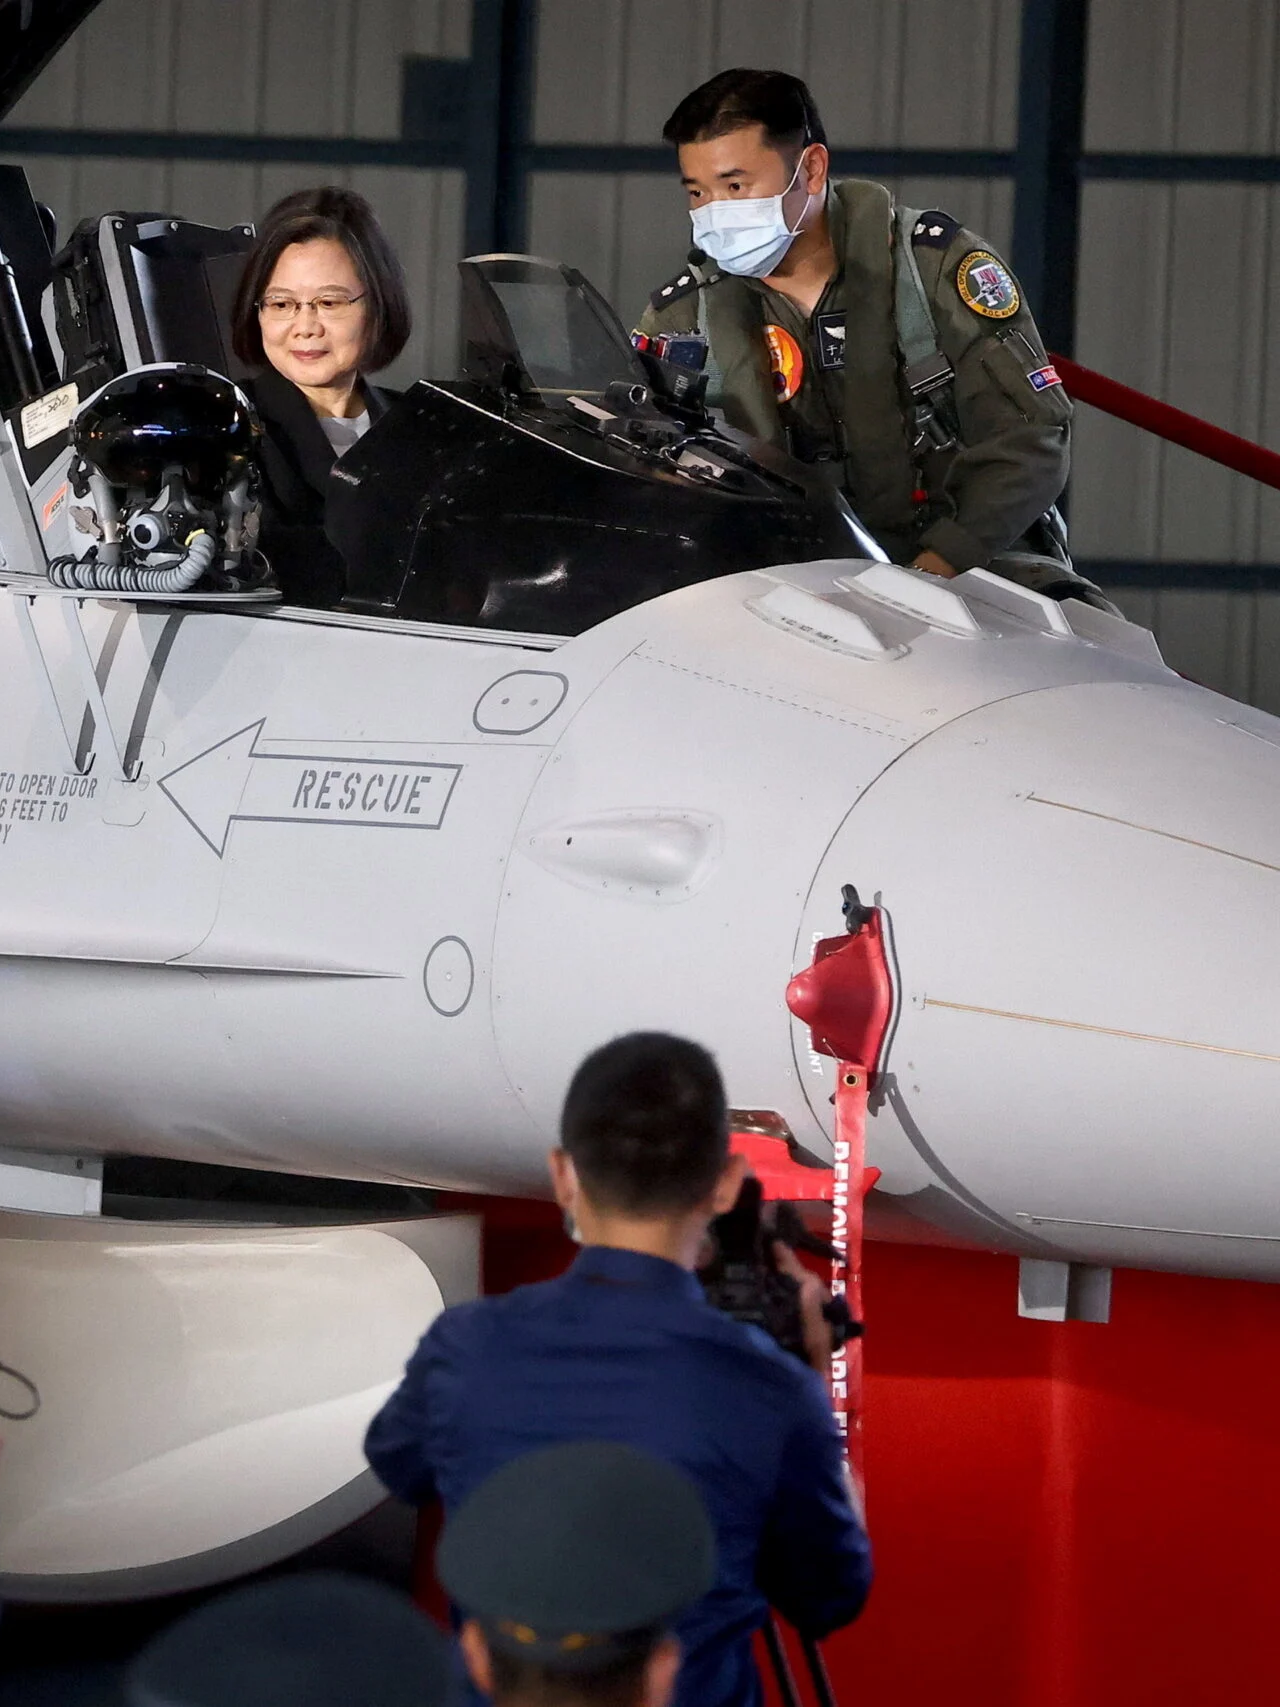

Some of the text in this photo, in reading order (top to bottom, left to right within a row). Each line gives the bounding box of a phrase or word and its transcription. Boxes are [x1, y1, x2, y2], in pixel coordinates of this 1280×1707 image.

[19, 774, 57, 796] OPEN
[59, 776, 98, 799] DOOR
[292, 769, 432, 814] RESCUE
[10, 799, 47, 821] FEET
[50, 801, 68, 822] TO
